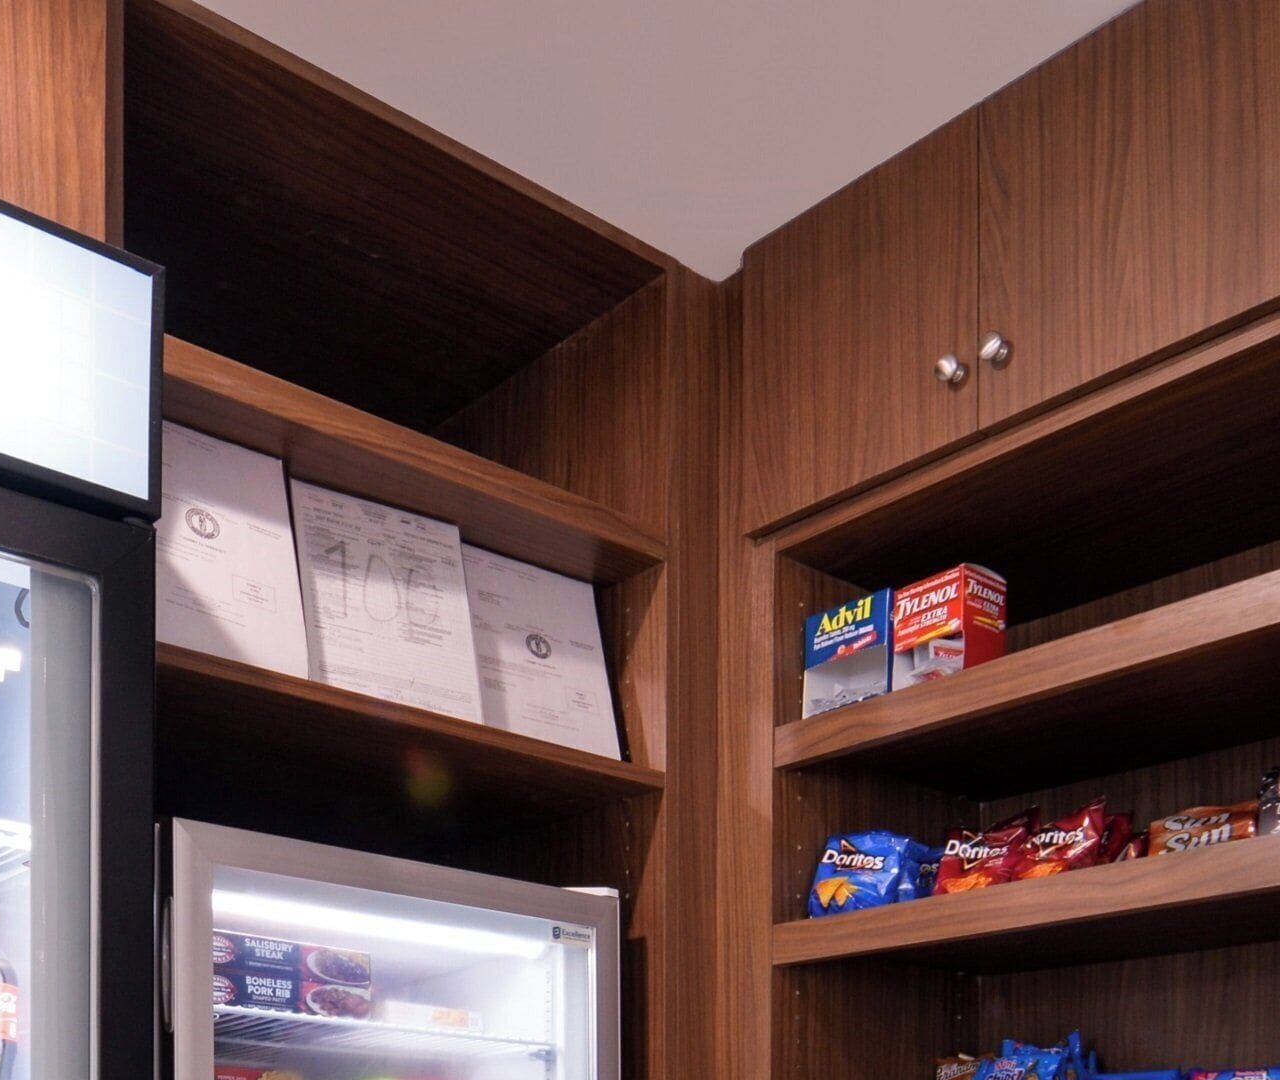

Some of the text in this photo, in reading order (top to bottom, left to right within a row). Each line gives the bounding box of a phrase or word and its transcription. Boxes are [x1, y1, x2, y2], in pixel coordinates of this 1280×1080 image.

[897, 582, 960, 621] TYLENOL
[967, 578, 1006, 606] TYLENOL
[816, 595, 872, 637] Advil
[1163, 812, 1231, 832] Sun
[1164, 822, 1232, 852] Sun
[821, 849, 886, 871] Doritos
[944, 839, 1009, 862] Doritos
[245, 938, 294, 953] SALISBURY
[255, 949, 284, 960] STEAK
[246, 976, 292, 988] BONELESS
[247, 986, 291, 998] PORK RIB
